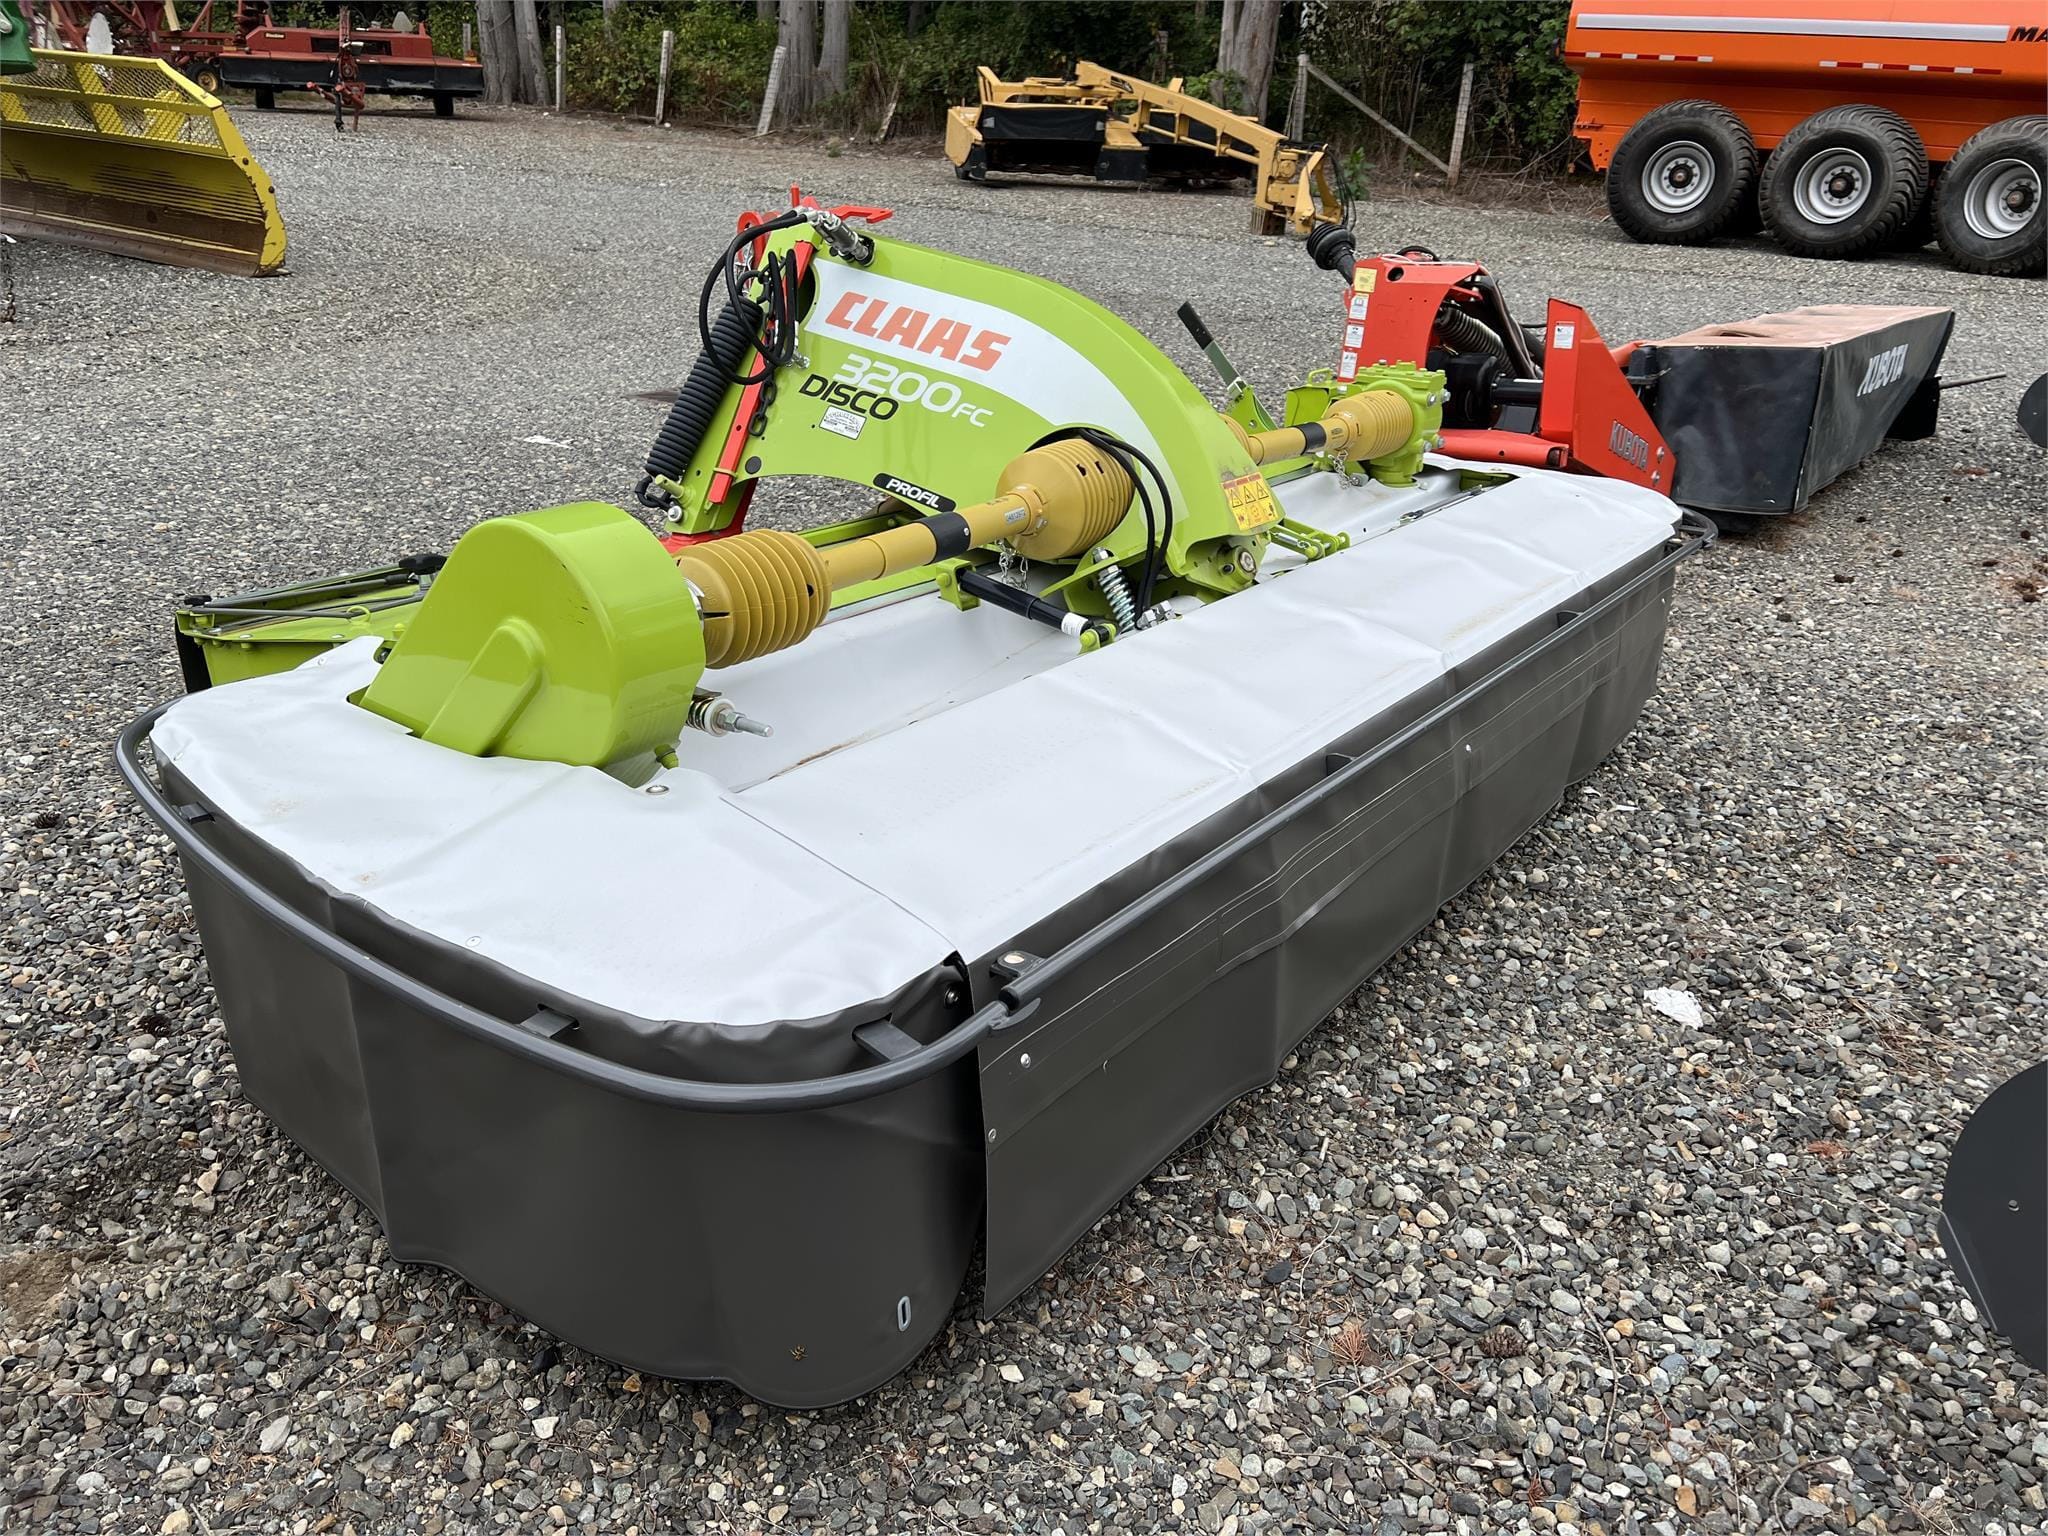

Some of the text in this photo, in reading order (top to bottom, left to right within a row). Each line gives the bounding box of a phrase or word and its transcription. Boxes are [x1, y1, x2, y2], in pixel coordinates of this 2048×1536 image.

[825, 291, 1012, 371] CLAAS
[1857, 344, 1909, 397] KUBOTA
[799, 374, 899, 420] DISCO
[1609, 419, 1649, 471] KUBOTA
[886, 479, 939, 508] PROFIL
